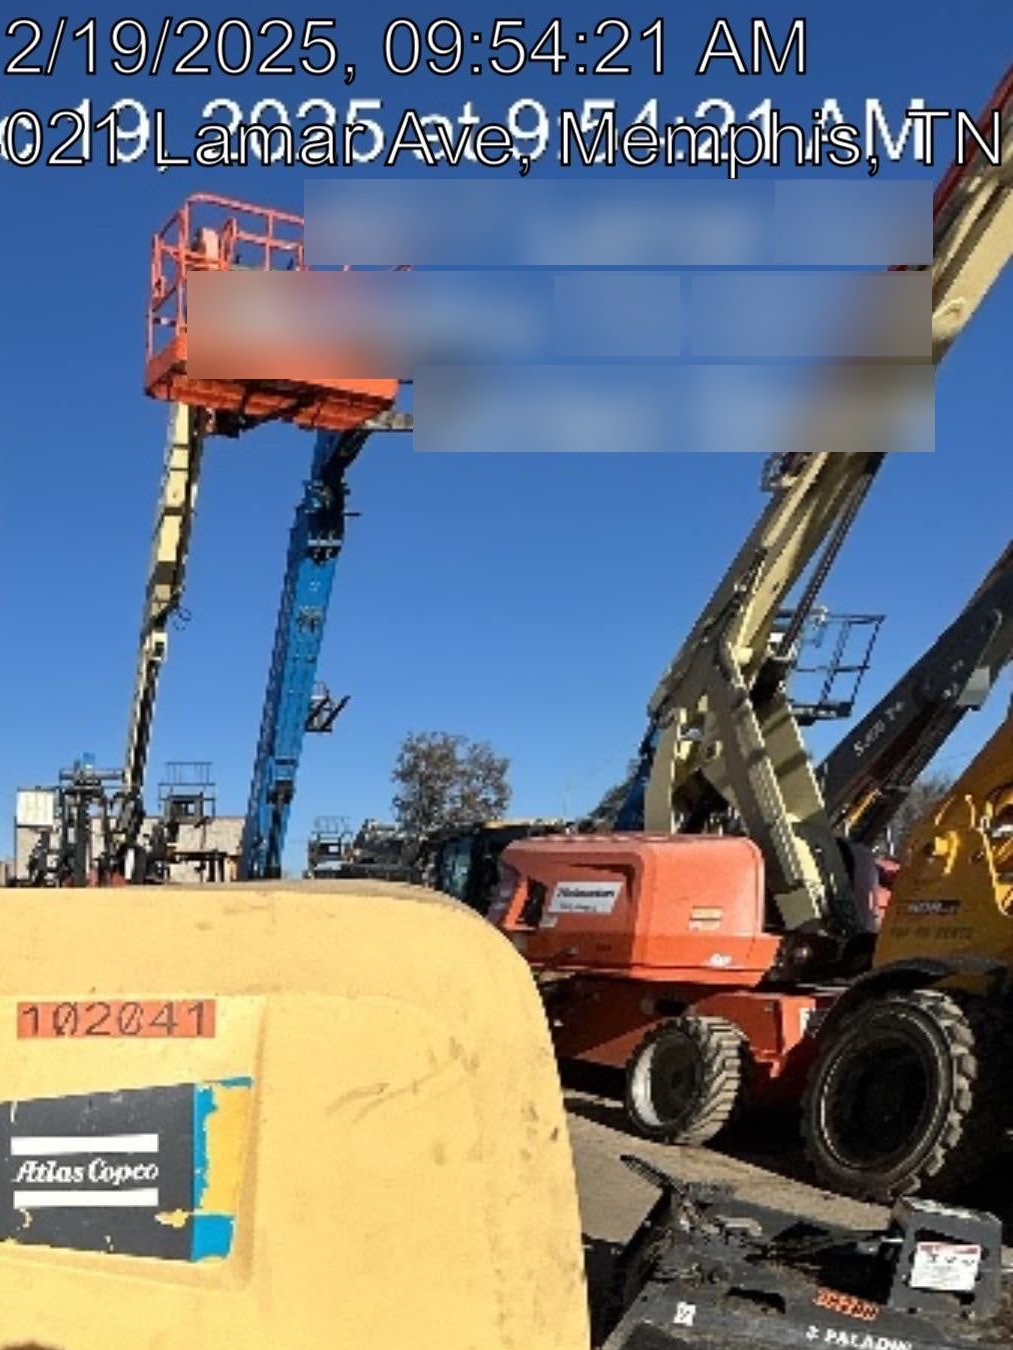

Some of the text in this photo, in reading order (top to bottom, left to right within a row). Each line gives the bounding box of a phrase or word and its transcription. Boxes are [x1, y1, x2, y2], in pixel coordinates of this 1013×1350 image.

[22, 1001, 203, 1036] 102041
[11, 1157, 160, 1186] Atlas Copco
